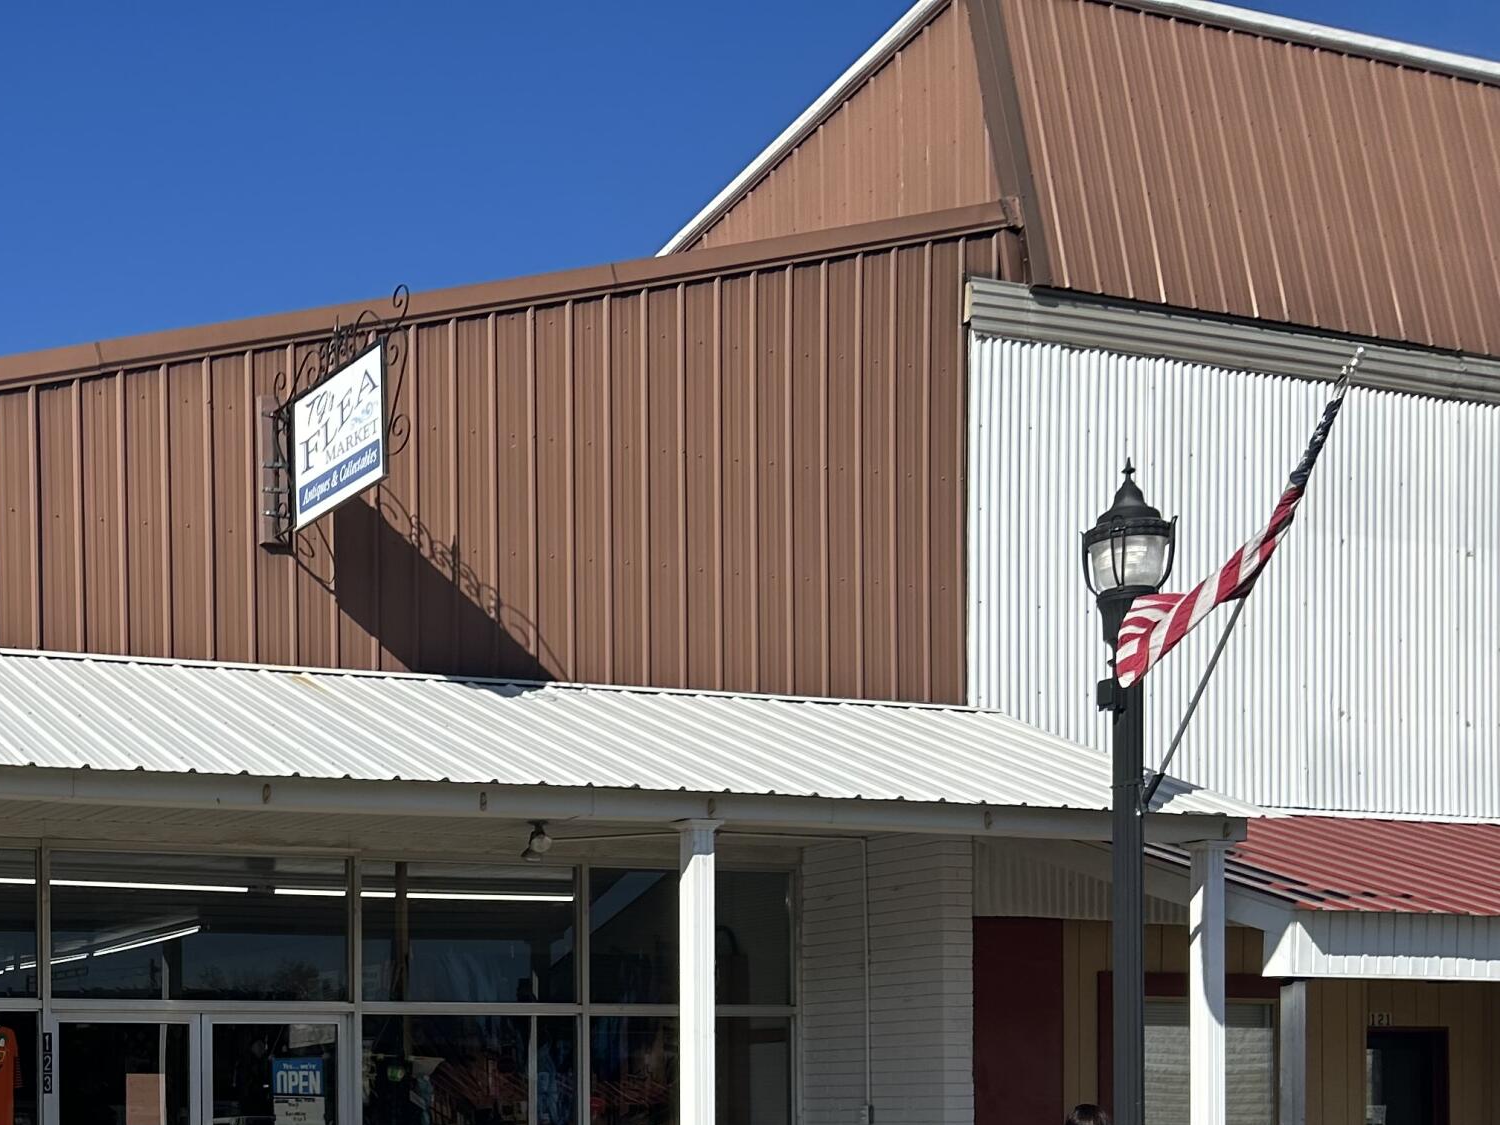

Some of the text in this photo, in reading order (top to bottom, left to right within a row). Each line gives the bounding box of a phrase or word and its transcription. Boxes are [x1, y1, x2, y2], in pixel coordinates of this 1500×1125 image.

[300, 369, 378, 474] FLEA
[325, 417, 379, 464] MARKET
[302, 480, 331, 506] Antiques
[331, 470, 339, 488] &
[1371, 1012, 1391, 1026] 121
[43, 1033, 52, 1093] 123
[276, 1070, 321, 1094] OPEN
